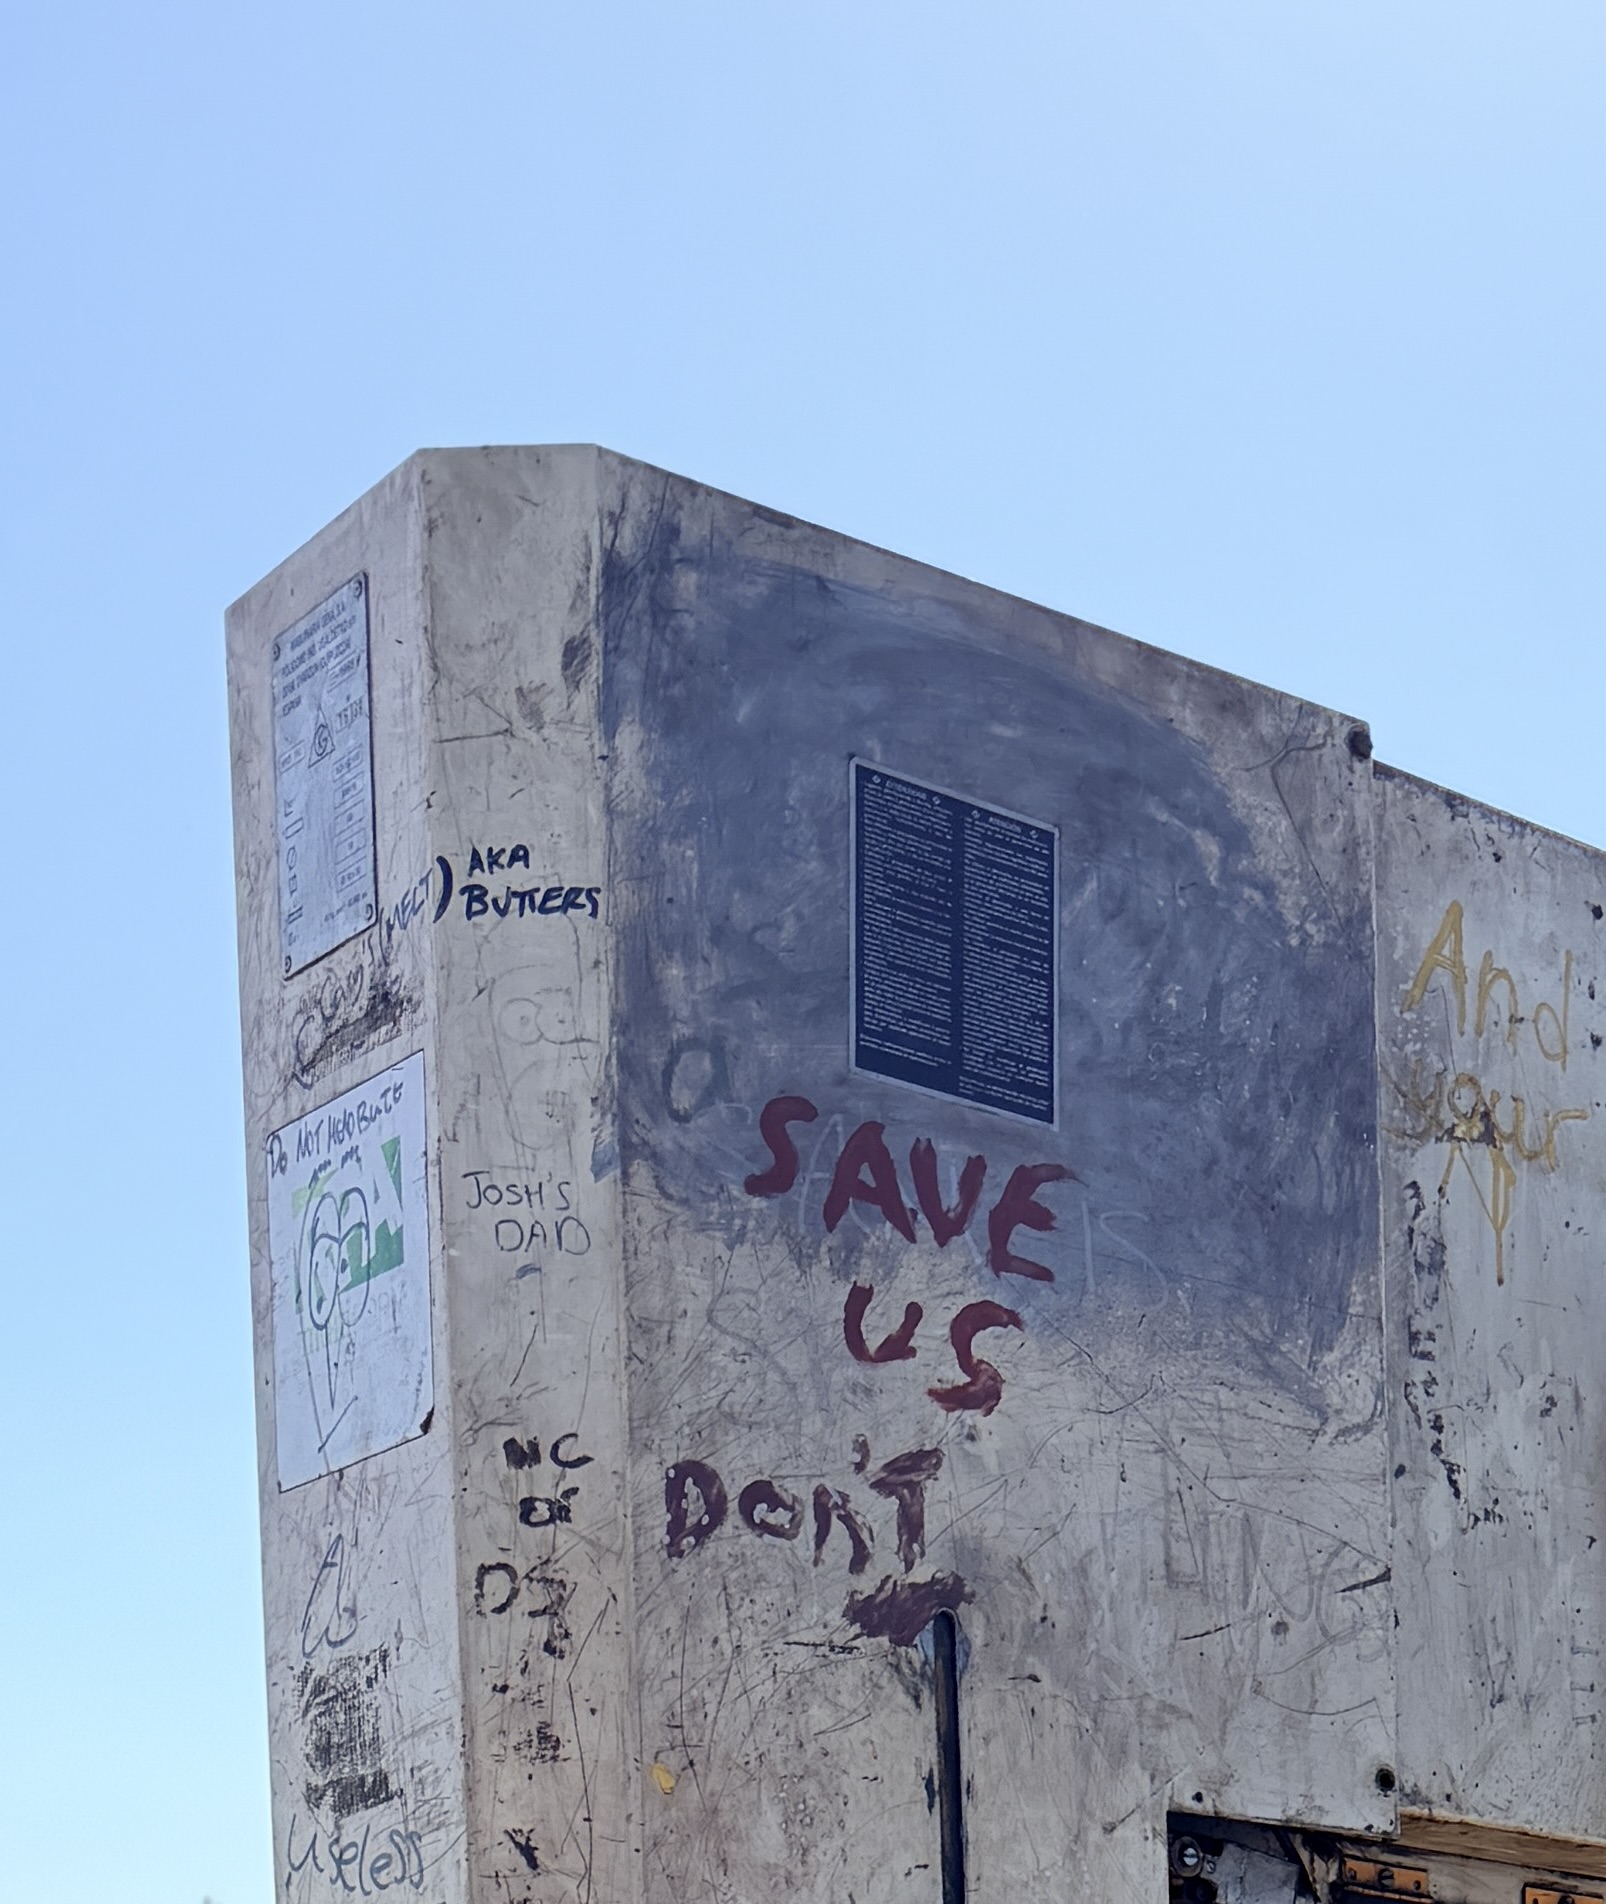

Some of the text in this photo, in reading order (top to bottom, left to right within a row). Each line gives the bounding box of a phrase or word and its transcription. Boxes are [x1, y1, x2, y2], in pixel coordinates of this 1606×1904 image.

[467, 844, 529, 878] AKA
[459, 883, 602, 921] BUTTERS
[1401, 900, 1574, 1074] And
[296, 1119, 324, 1163] NOT
[461, 1171, 571, 1210] JOSH'S
[744, 1096, 1087, 1283] SAVE
[495, 1216, 591, 1256] DAD
[843, 1281, 1025, 1417] US
